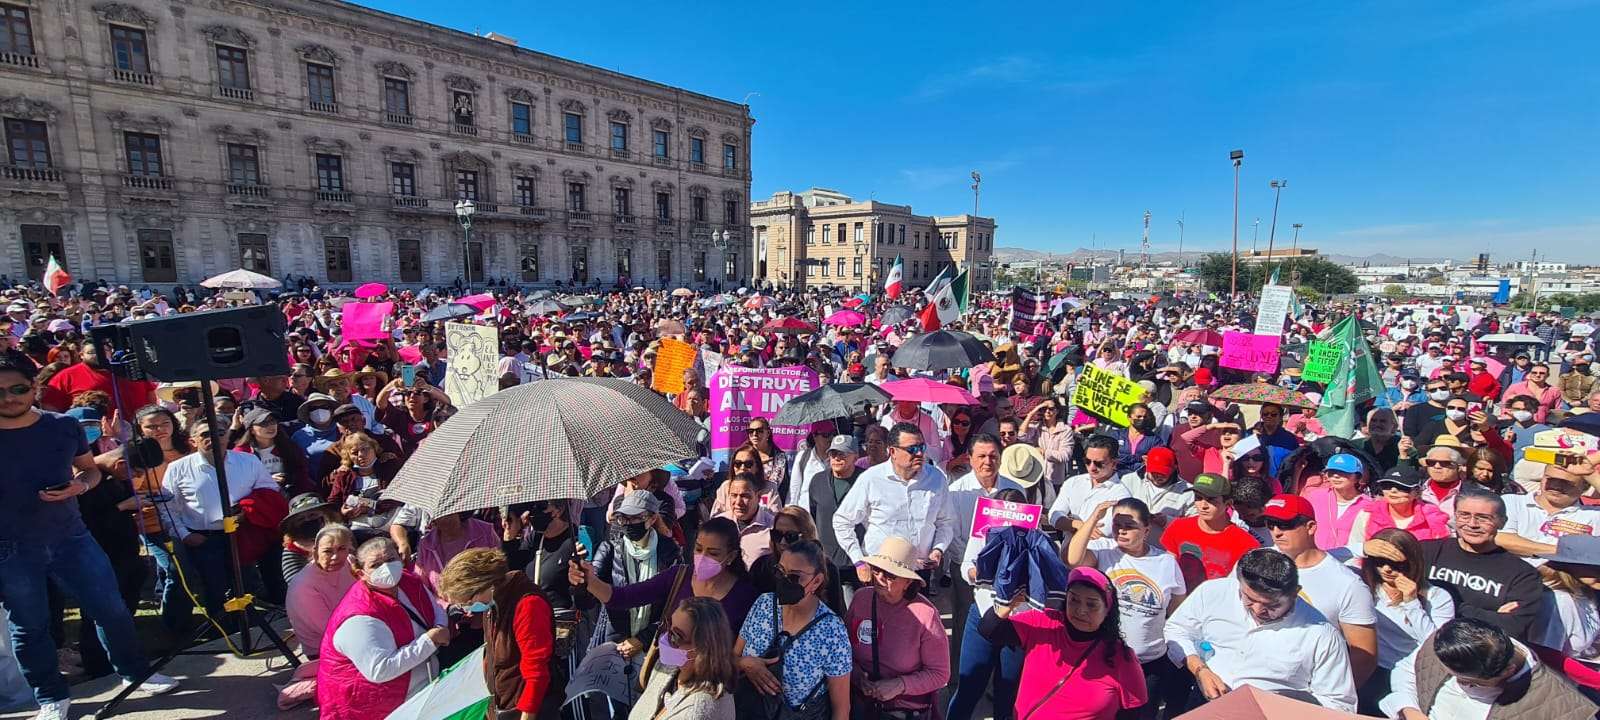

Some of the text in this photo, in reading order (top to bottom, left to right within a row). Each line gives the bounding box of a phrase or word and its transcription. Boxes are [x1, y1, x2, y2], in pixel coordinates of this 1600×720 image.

[718, 375, 811, 392] DESTRUYE
[1095, 371, 1114, 388] INE
[1117, 381, 1132, 395] SE
[720, 391, 753, 412] AL
[982, 507, 1035, 523] DEFIENDO
[1003, 501, 1018, 511] YO
[1428, 565, 1505, 598] LENNON
